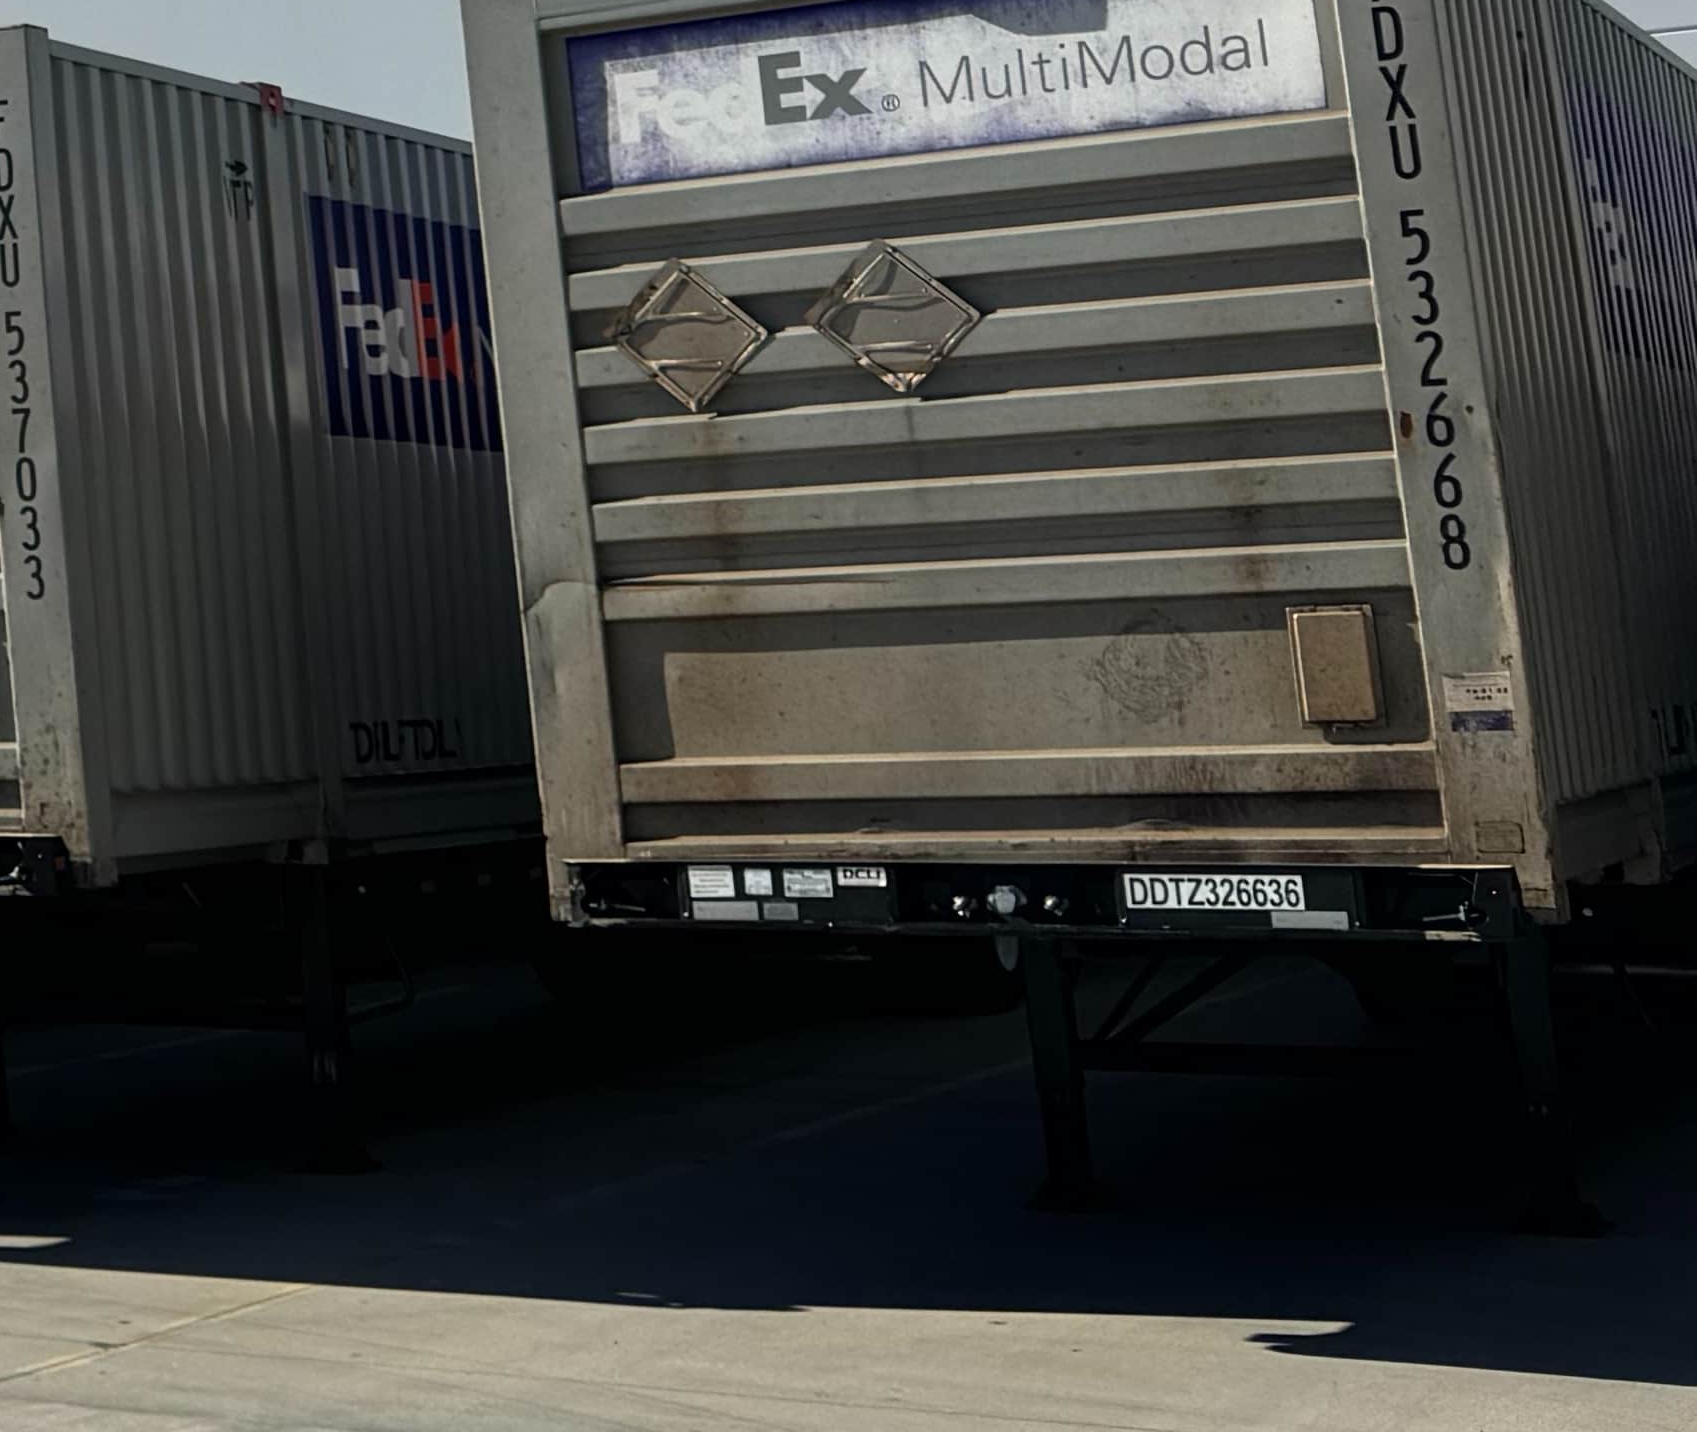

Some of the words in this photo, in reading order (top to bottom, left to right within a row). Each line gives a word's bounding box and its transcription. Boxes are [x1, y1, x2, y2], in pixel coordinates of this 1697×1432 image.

[917, 18, 1270, 108] MultiModal
[4, 311, 46, 601] 537033
[1399, 209, 1472, 571] 532668
[1128, 877, 1300, 908] DDTZ326636
